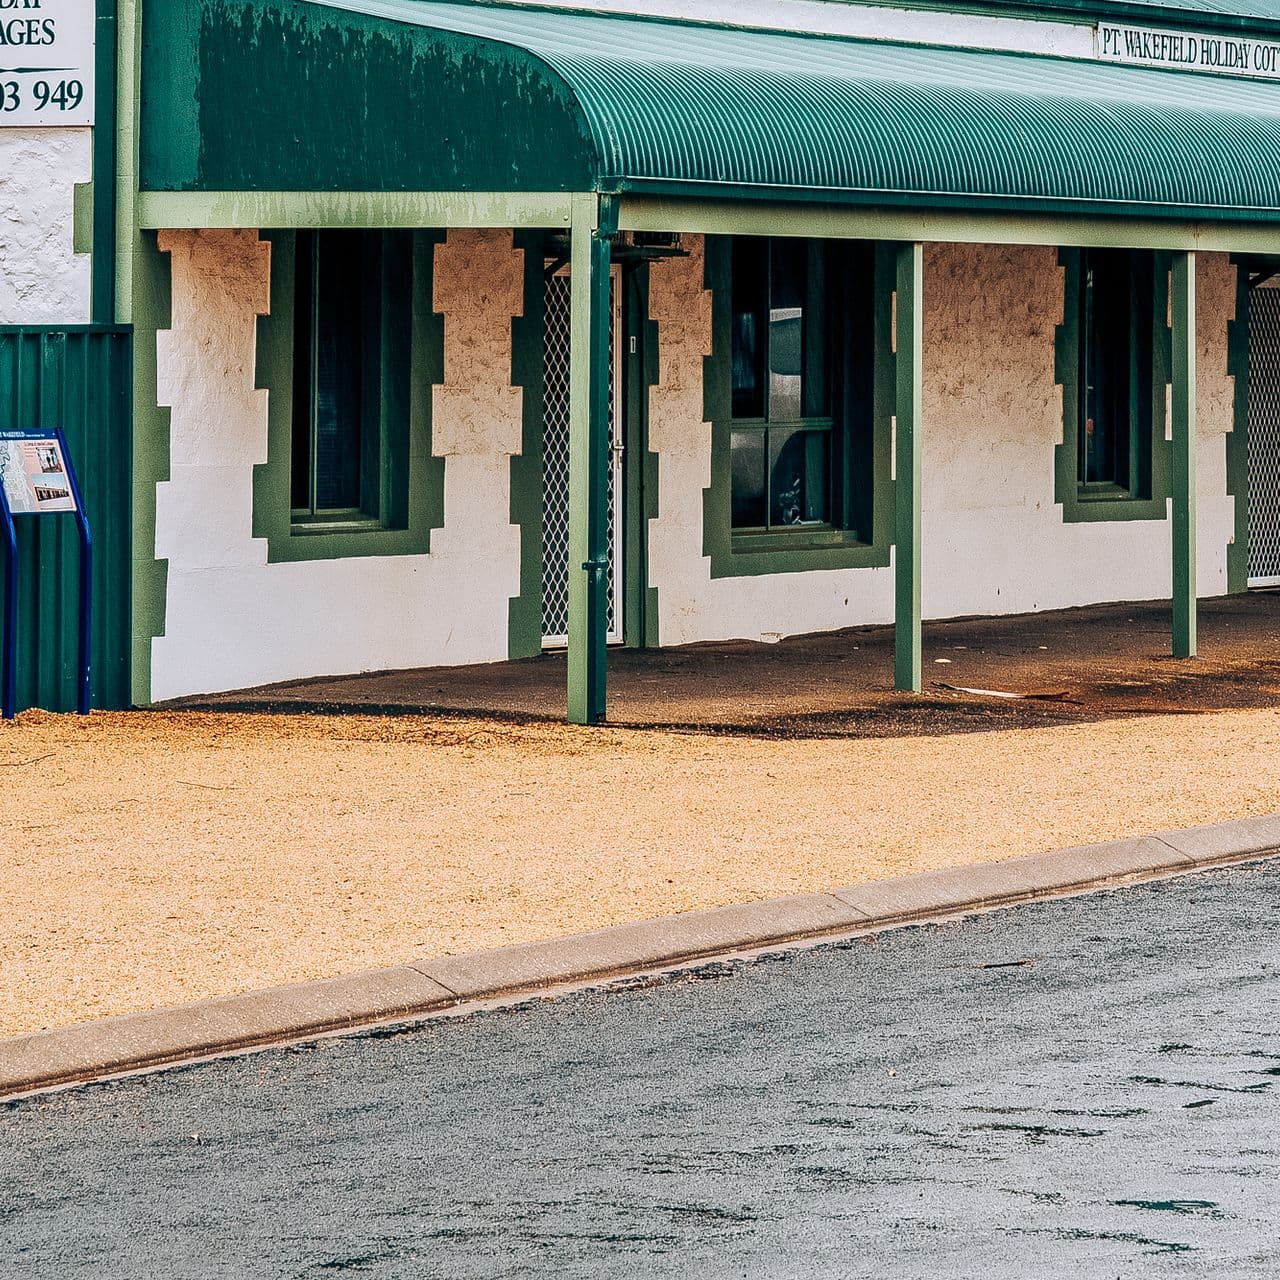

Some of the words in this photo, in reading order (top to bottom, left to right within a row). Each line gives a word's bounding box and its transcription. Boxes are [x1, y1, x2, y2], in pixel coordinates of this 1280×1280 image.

[1102, 27, 1121, 56] PT.
[1124, 29, 1198, 65] WAKEFIELD
[1200, 38, 1252, 69] HOLIDAY
[32, 79, 84, 112] 949
